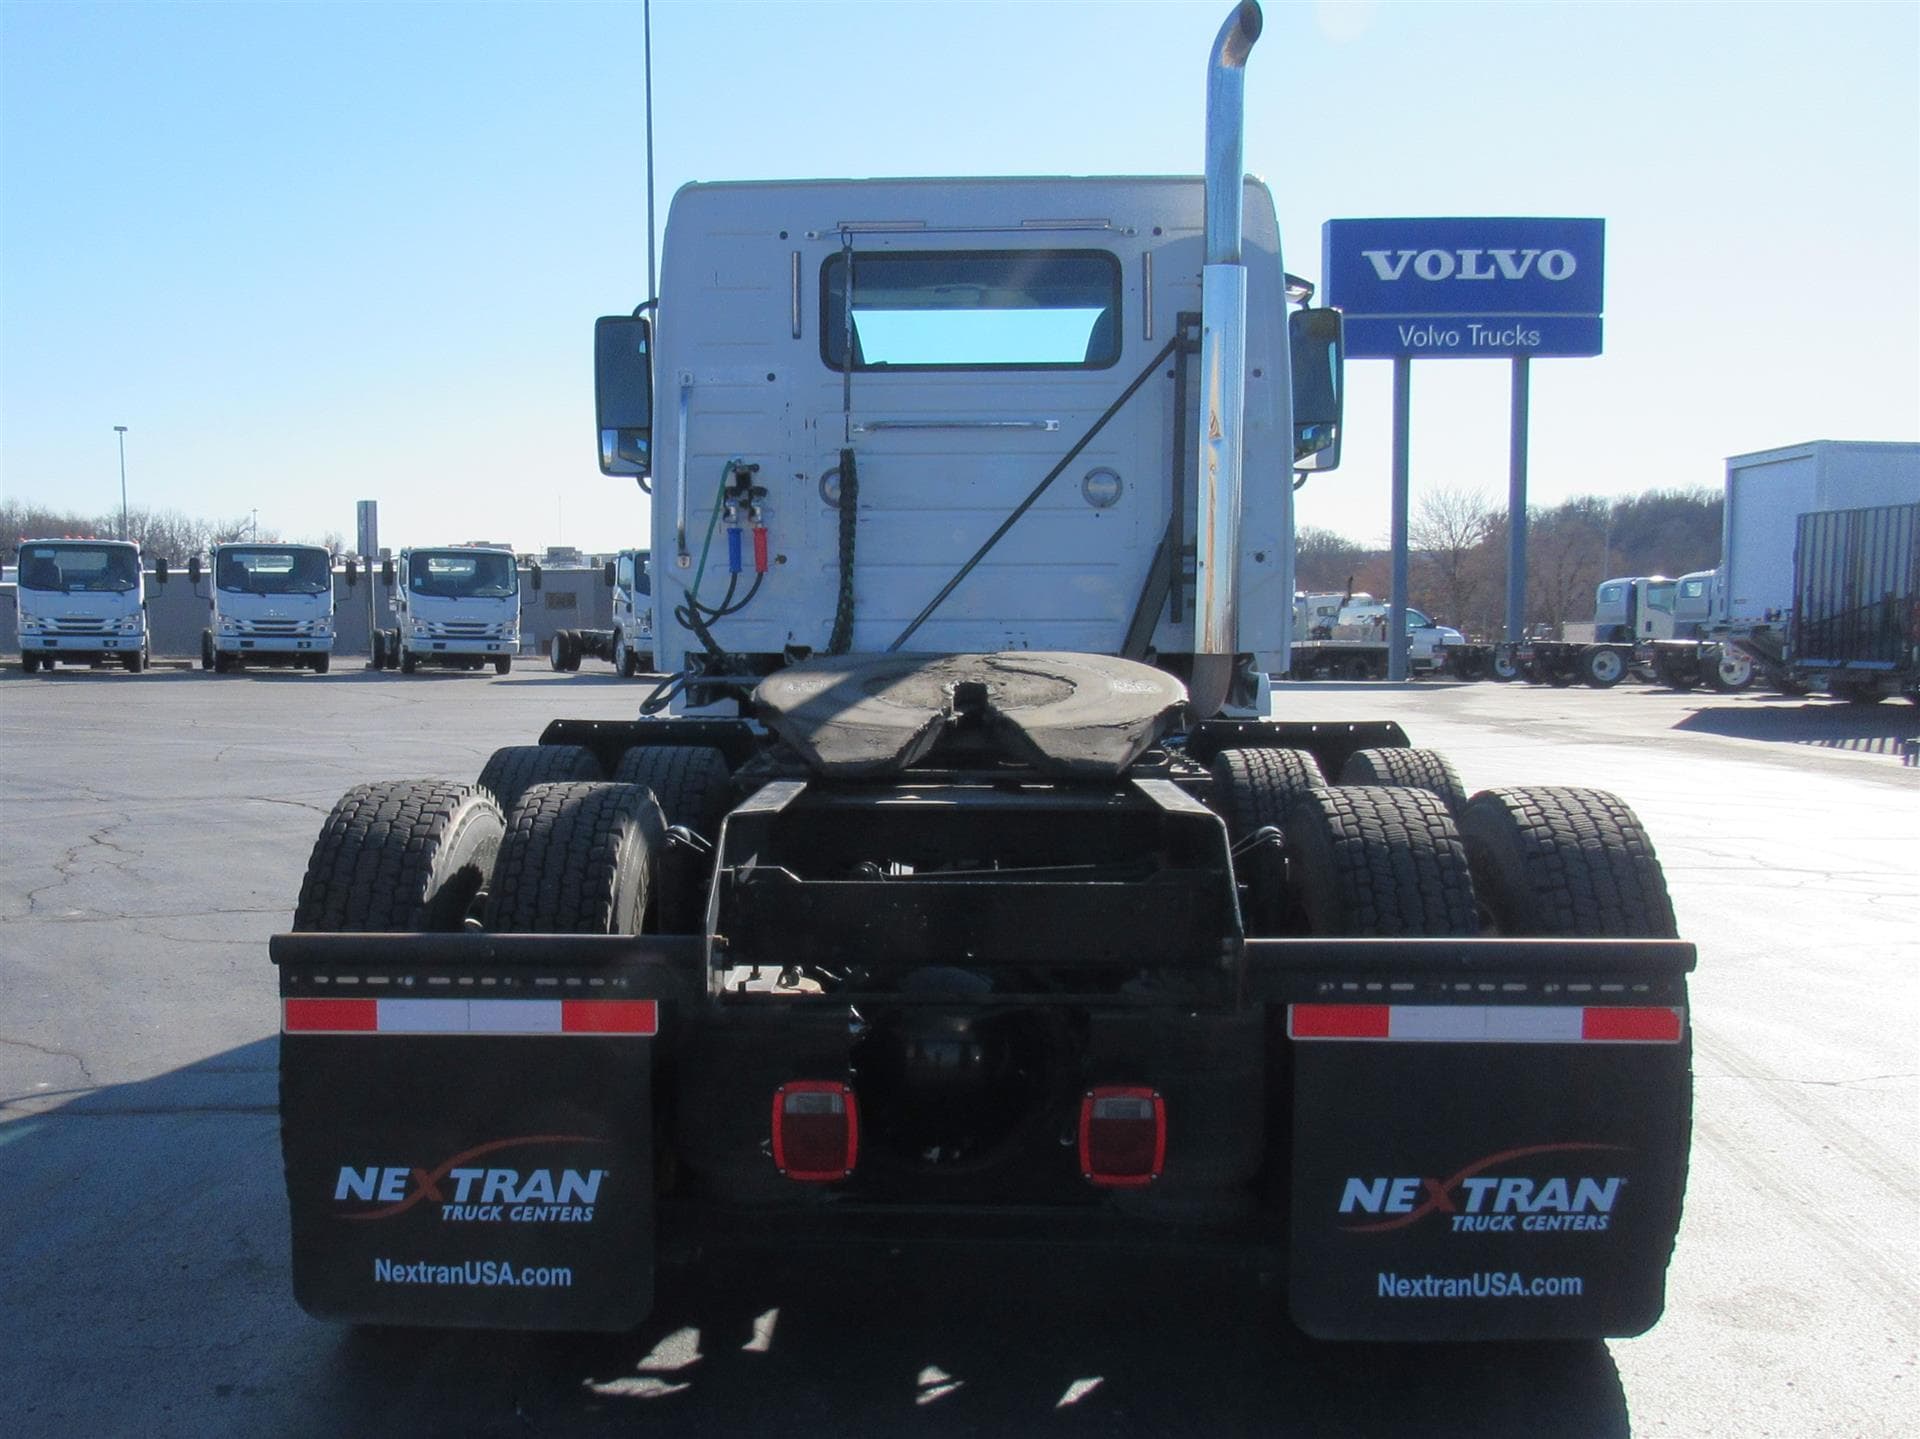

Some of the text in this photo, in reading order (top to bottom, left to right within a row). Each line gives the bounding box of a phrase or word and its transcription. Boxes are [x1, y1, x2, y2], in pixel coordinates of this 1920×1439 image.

[1361, 248, 1577, 281] VOLVO
[1398, 324, 1541, 347] Volvo Trucks
[334, 1166, 603, 1204] NEXTRAN
[1338, 1177, 1620, 1214] NEXTRAN
[441, 1204, 594, 1222] TRUCK CENTERS
[1451, 1214, 1610, 1232] TRUCK CENTERS
[374, 1258, 572, 1287] NextranUSA.com
[1377, 1271, 1583, 1298] NextranUSA.com
